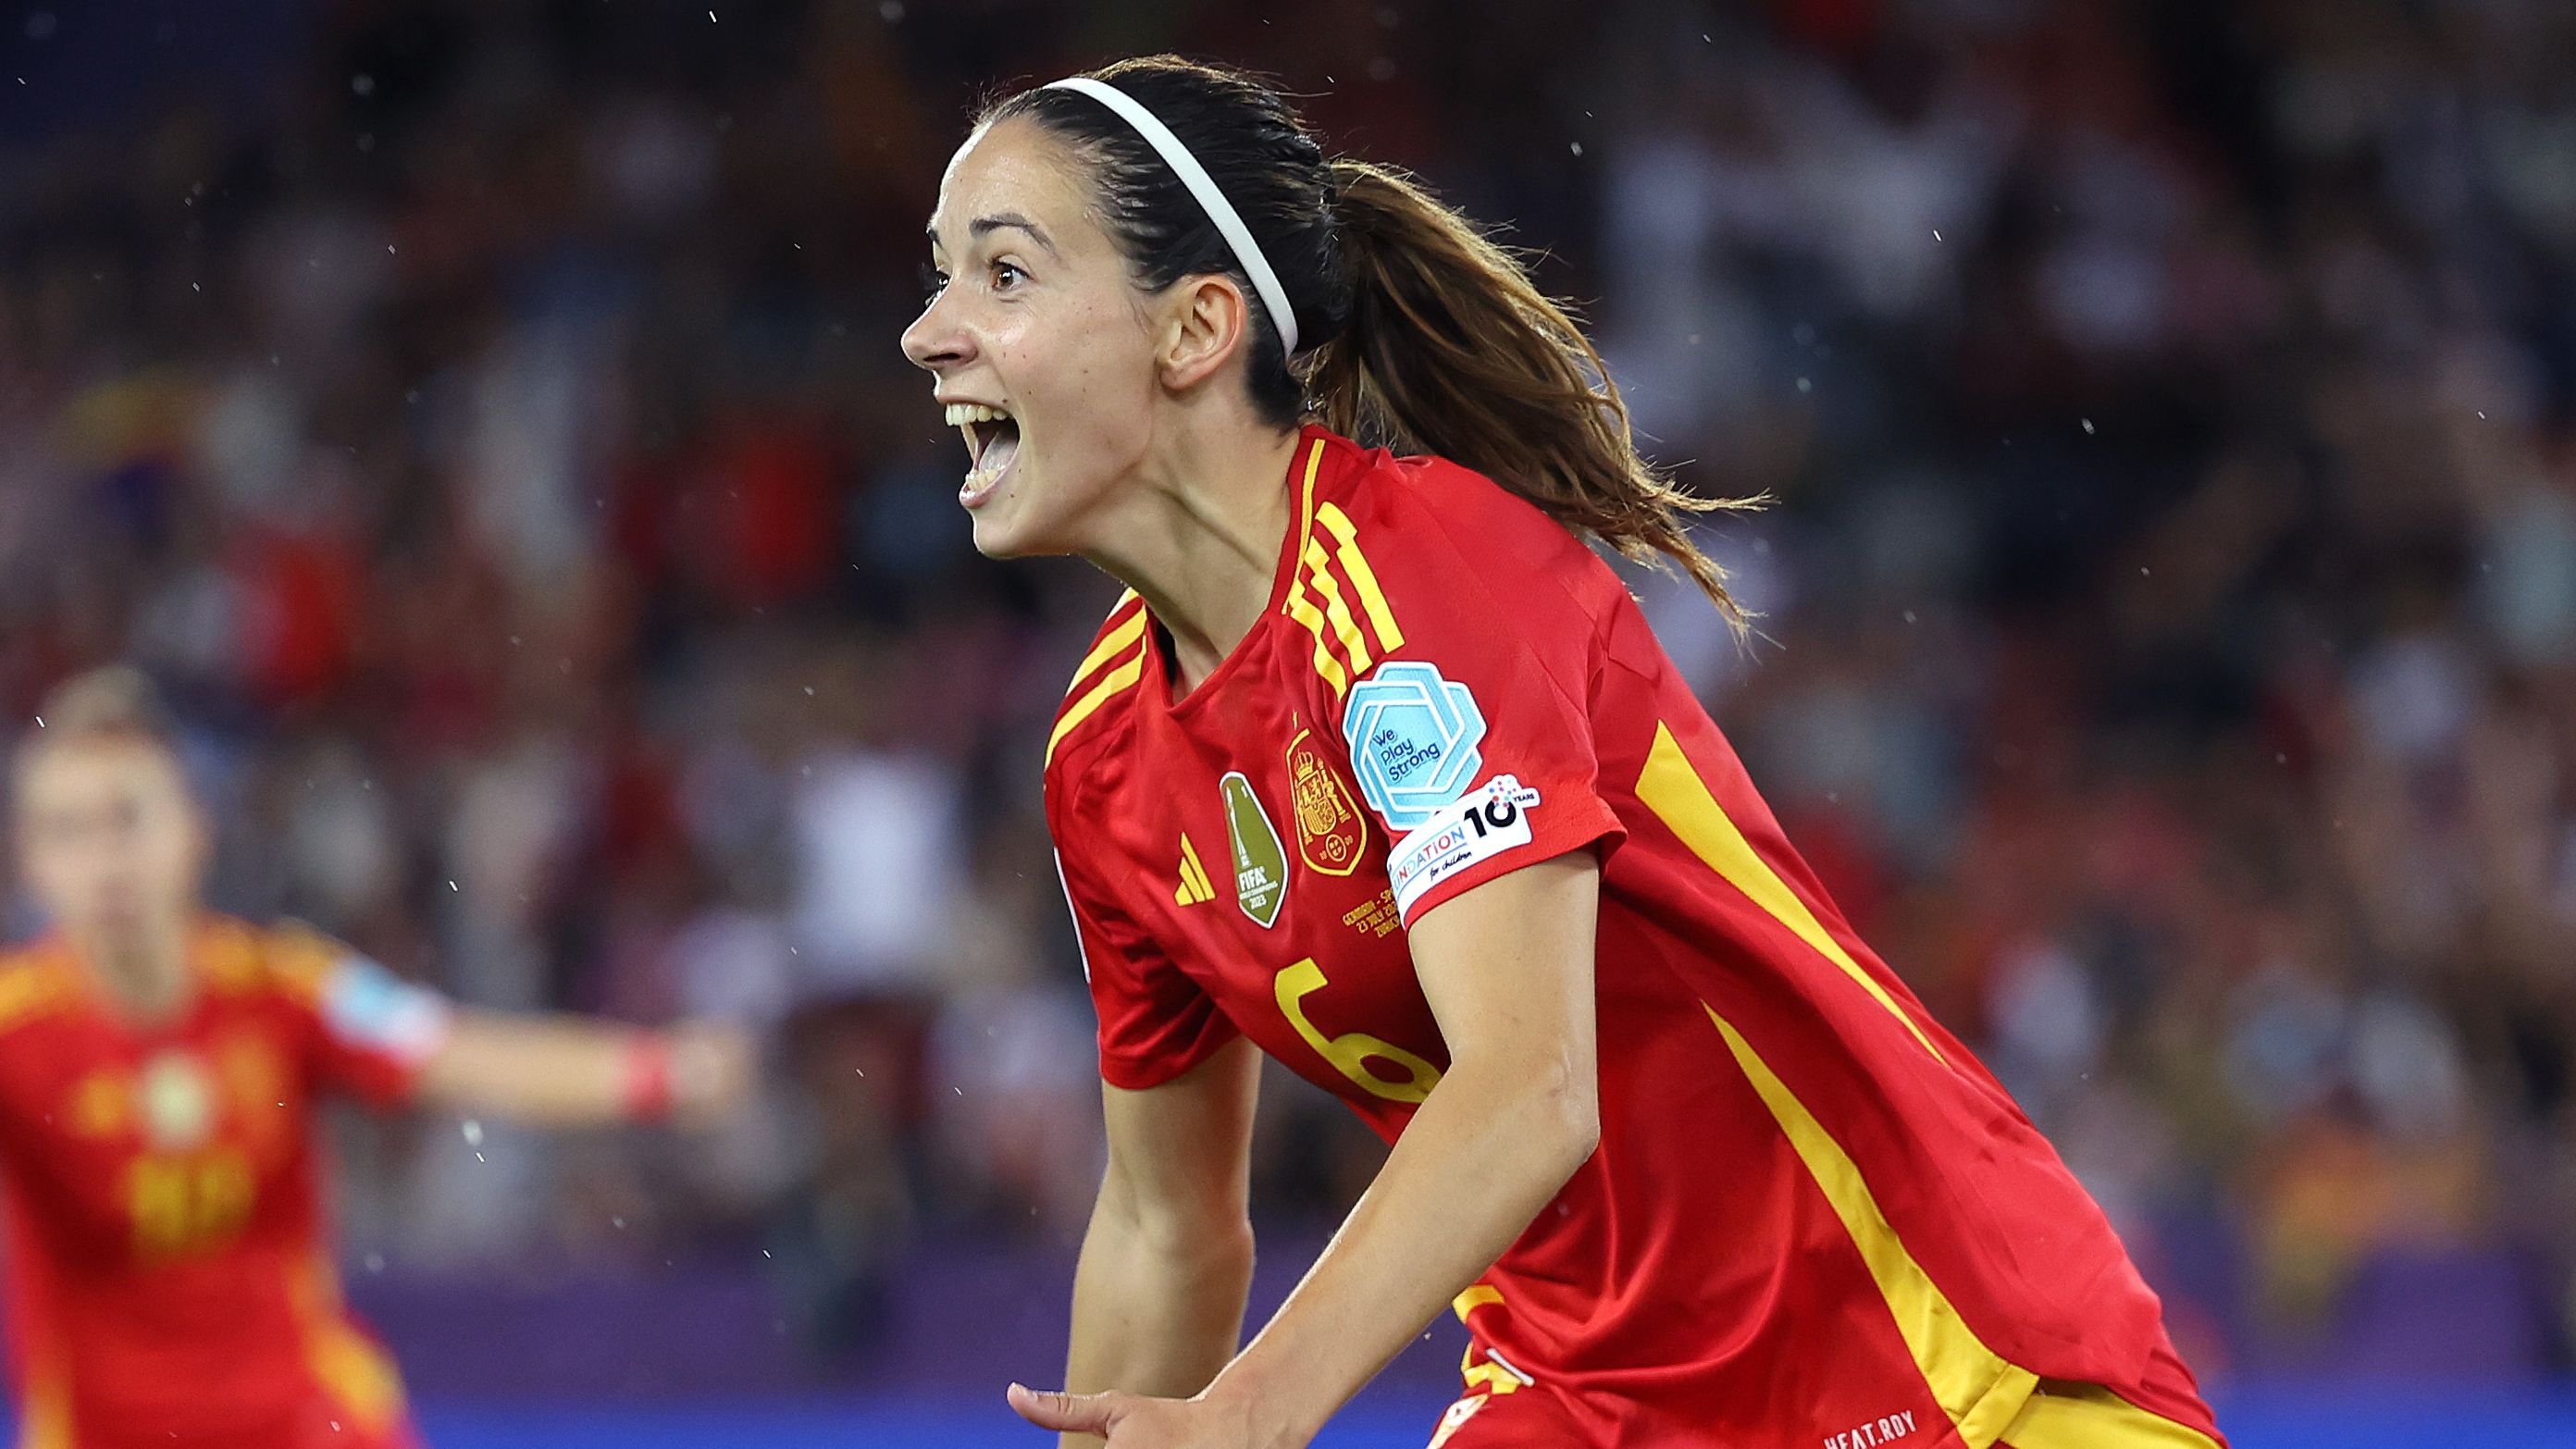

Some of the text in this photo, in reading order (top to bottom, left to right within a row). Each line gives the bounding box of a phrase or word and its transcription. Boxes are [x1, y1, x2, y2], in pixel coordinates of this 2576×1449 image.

[1372, 728, 1395, 747] We
[1389, 743, 1441, 782] Strong
[1464, 793, 1535, 838] 10 YEARS
[1393, 826, 1466, 891] UNDATION
[1430, 850, 1472, 882] for children
[1274, 957, 1444, 1104] 6
[1824, 1409, 1917, 1449] HEAT.RDY
